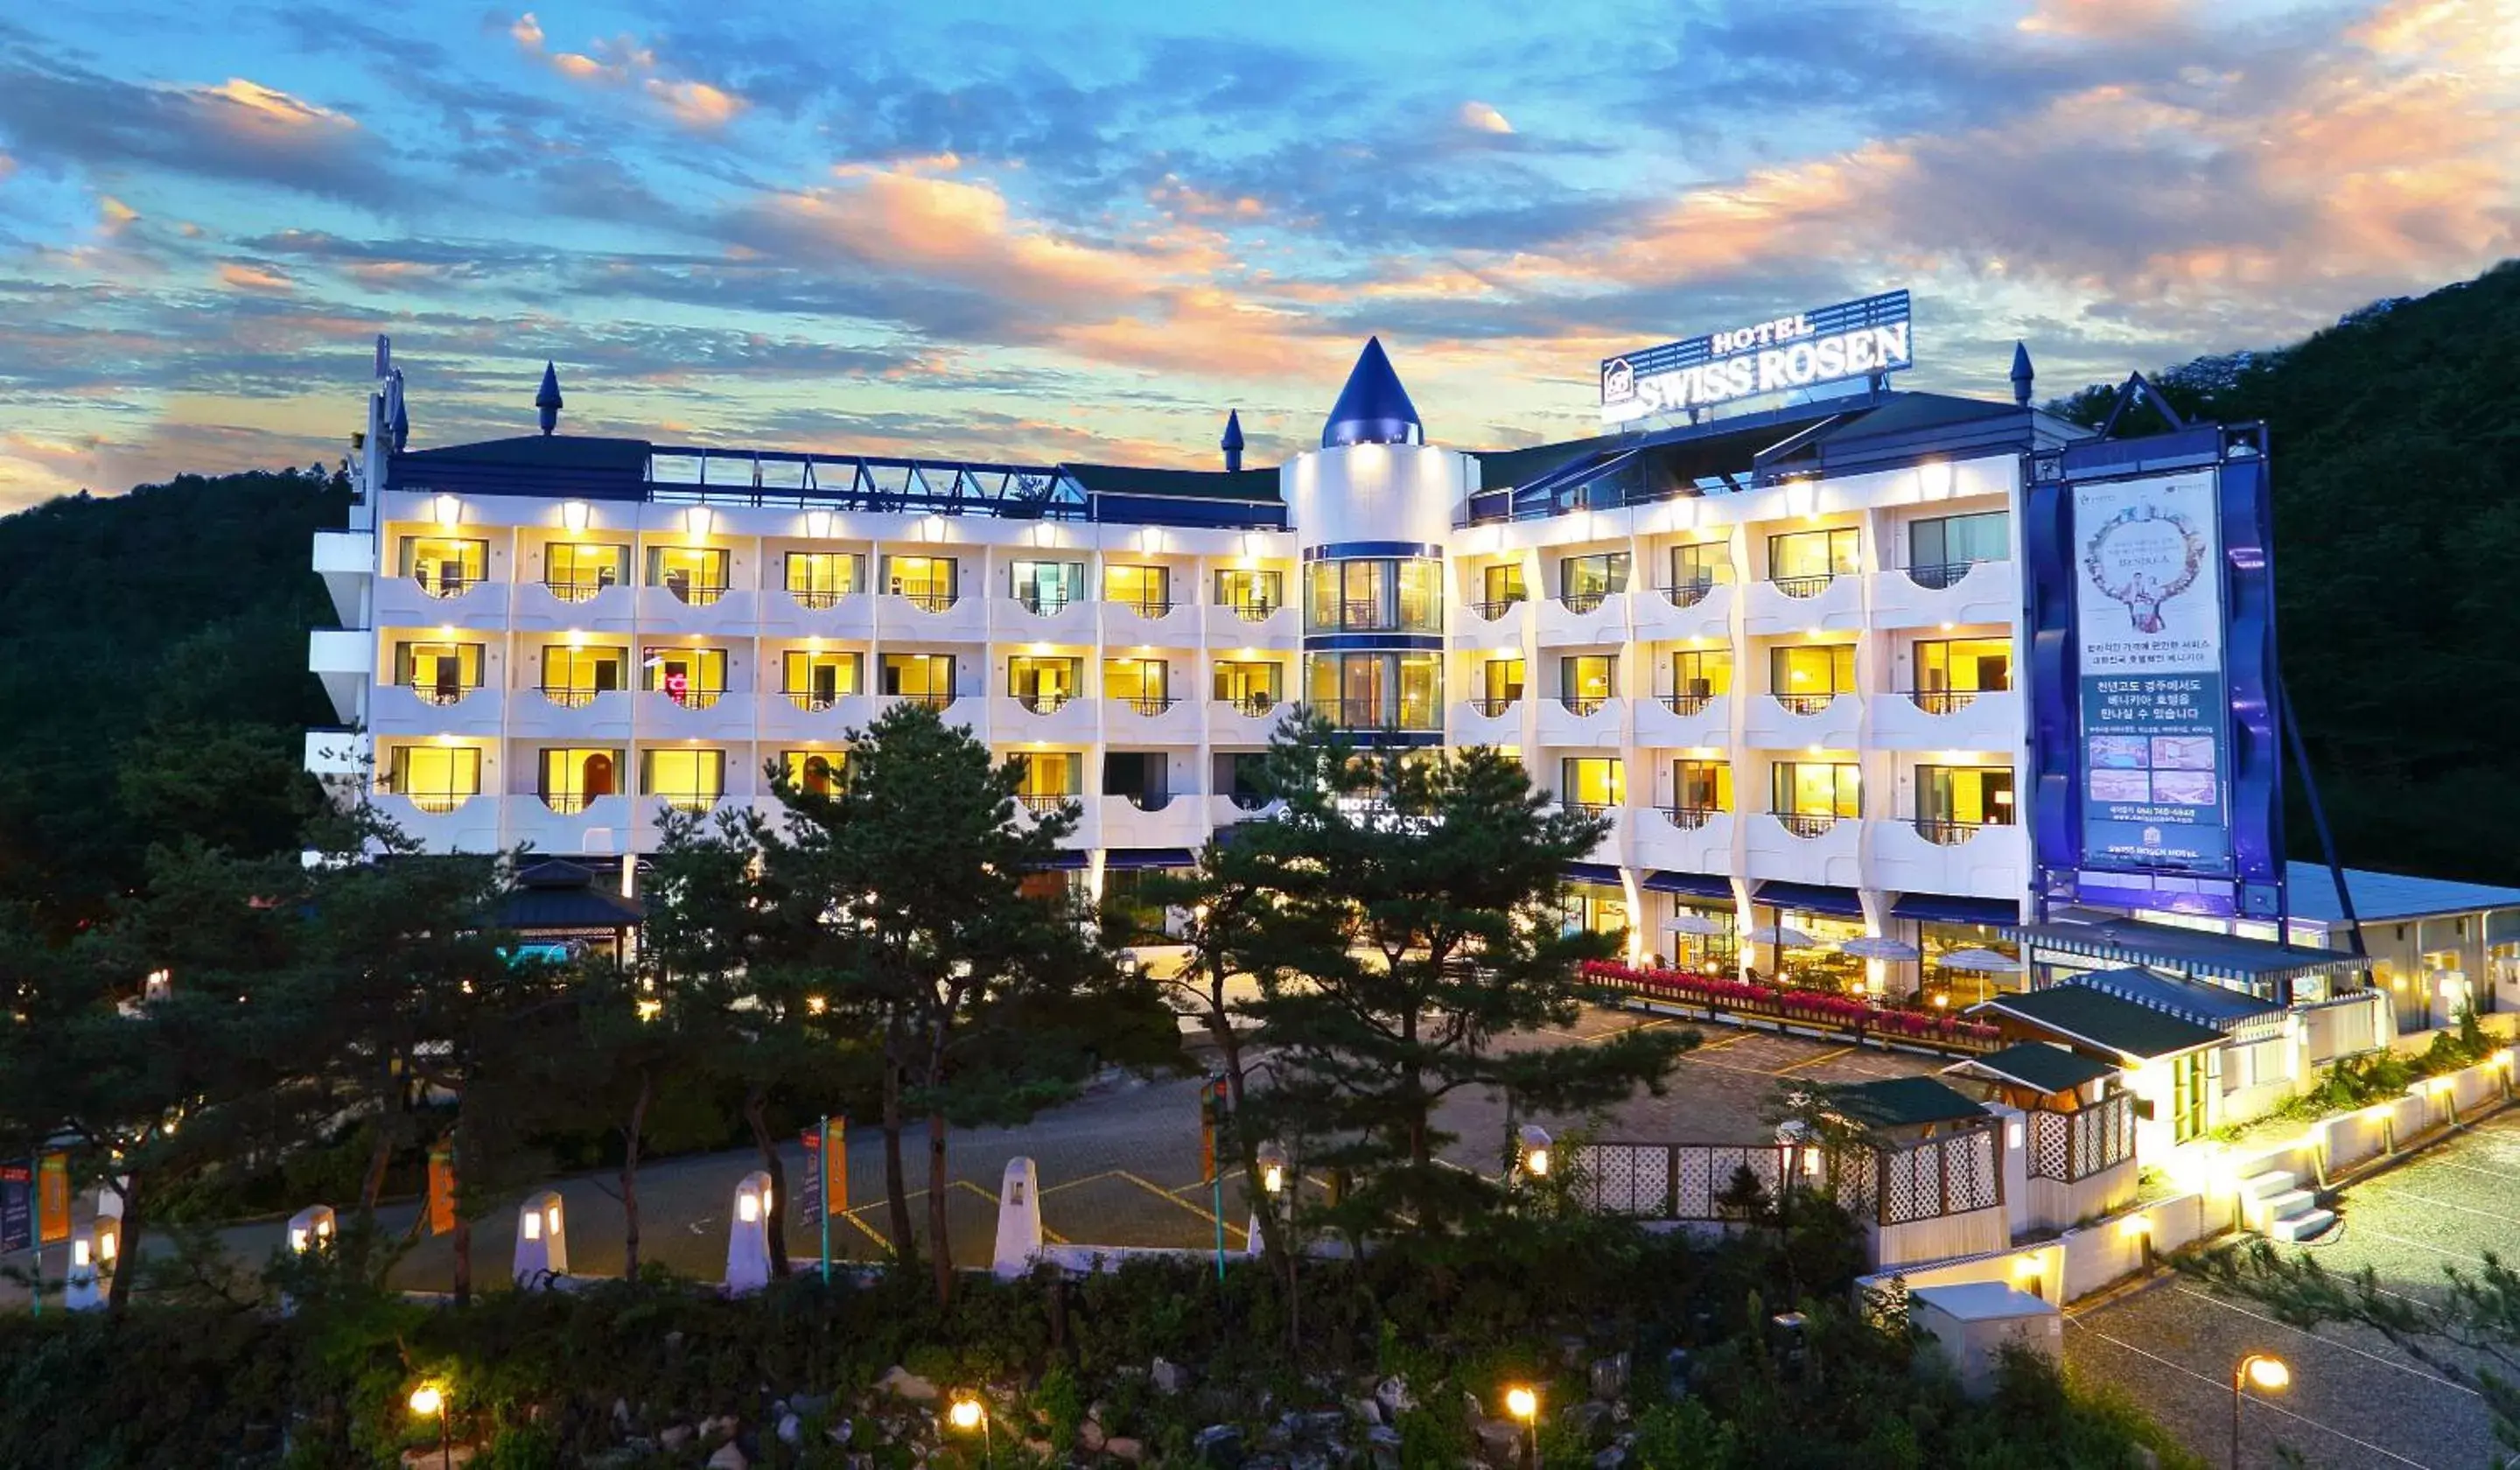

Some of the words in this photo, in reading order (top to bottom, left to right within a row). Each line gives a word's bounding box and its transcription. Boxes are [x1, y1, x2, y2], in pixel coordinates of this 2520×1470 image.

[1712, 314, 1816, 354] HOTEL
[1637, 356, 1752, 416] SWISS
[1757, 321, 1909, 392] ROSEN
[2097, 681, 2140, 693] 천년고도
[2144, 679, 2202, 693] 경주에서도
[2107, 694, 2152, 706] 베니키아
[2155, 693, 2190, 706] 호텔을
[2101, 708, 2133, 720] 만나실
[2138, 708, 2149, 720] 수
[2152, 708, 2199, 720] 있습니다
[1338, 798, 1395, 811] HOTEL
